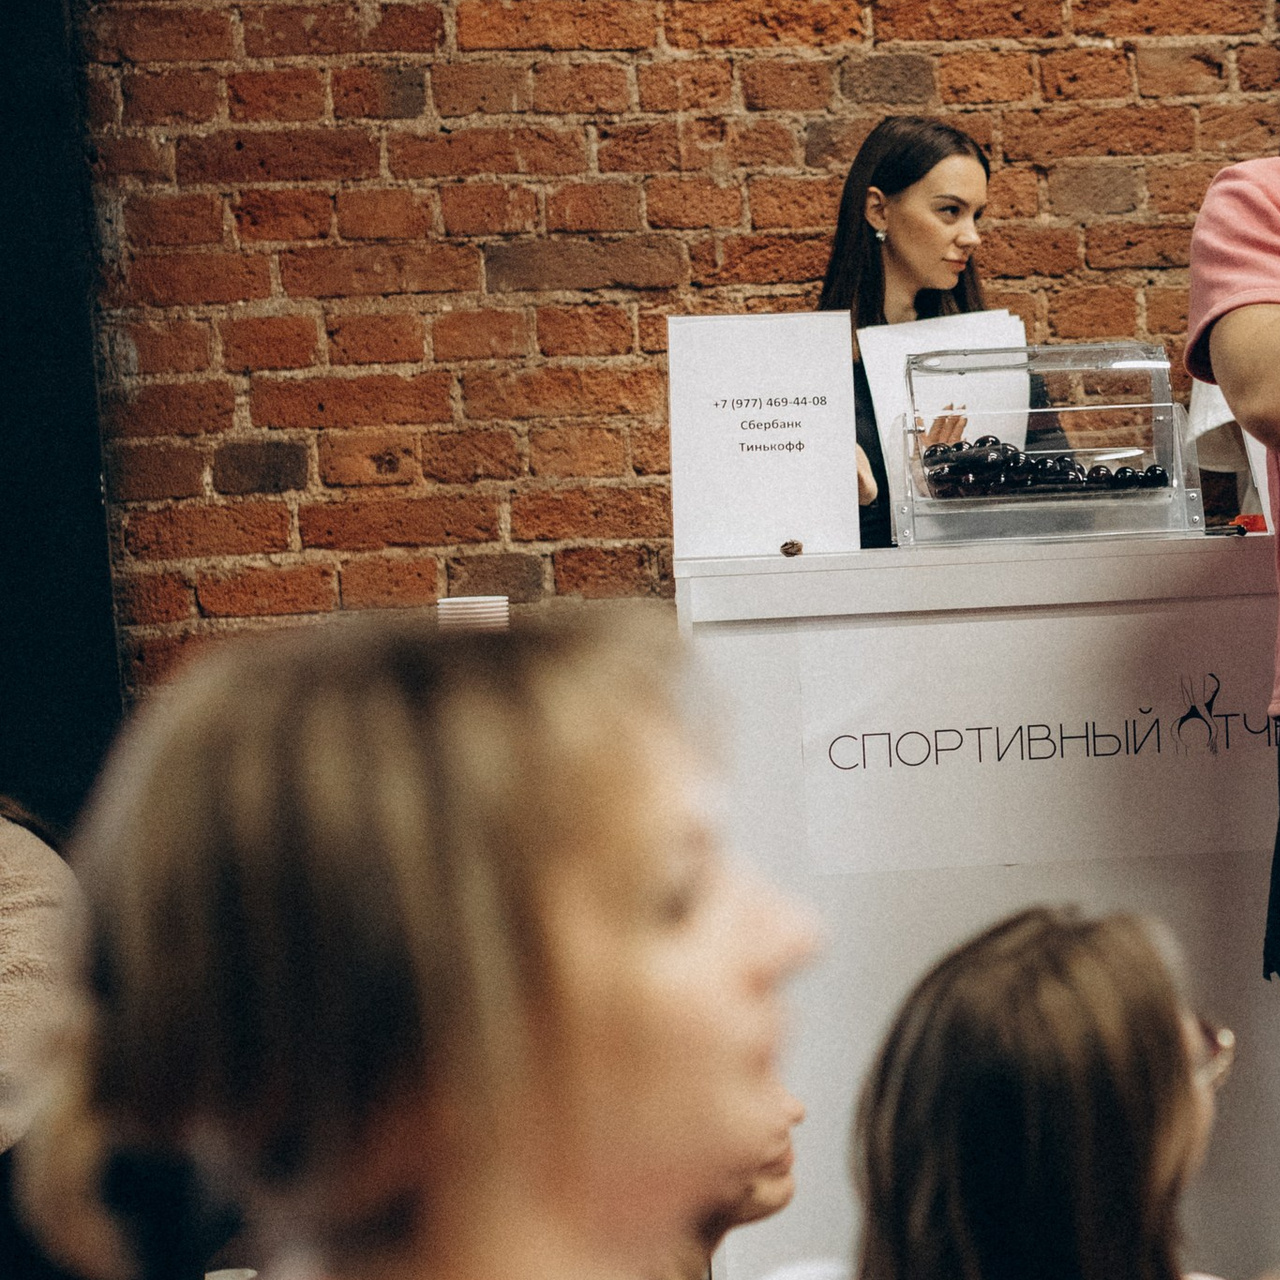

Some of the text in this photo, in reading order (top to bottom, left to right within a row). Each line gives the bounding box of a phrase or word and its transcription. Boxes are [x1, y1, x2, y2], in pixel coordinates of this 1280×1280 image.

[713, 396, 827, 410] +7 (977) 469-44-08
[740, 419, 802, 431] Сбербанк
[739, 440, 805, 452] Тинькофф
[828, 707, 1161, 770] СПОРТИВНЫЙ
